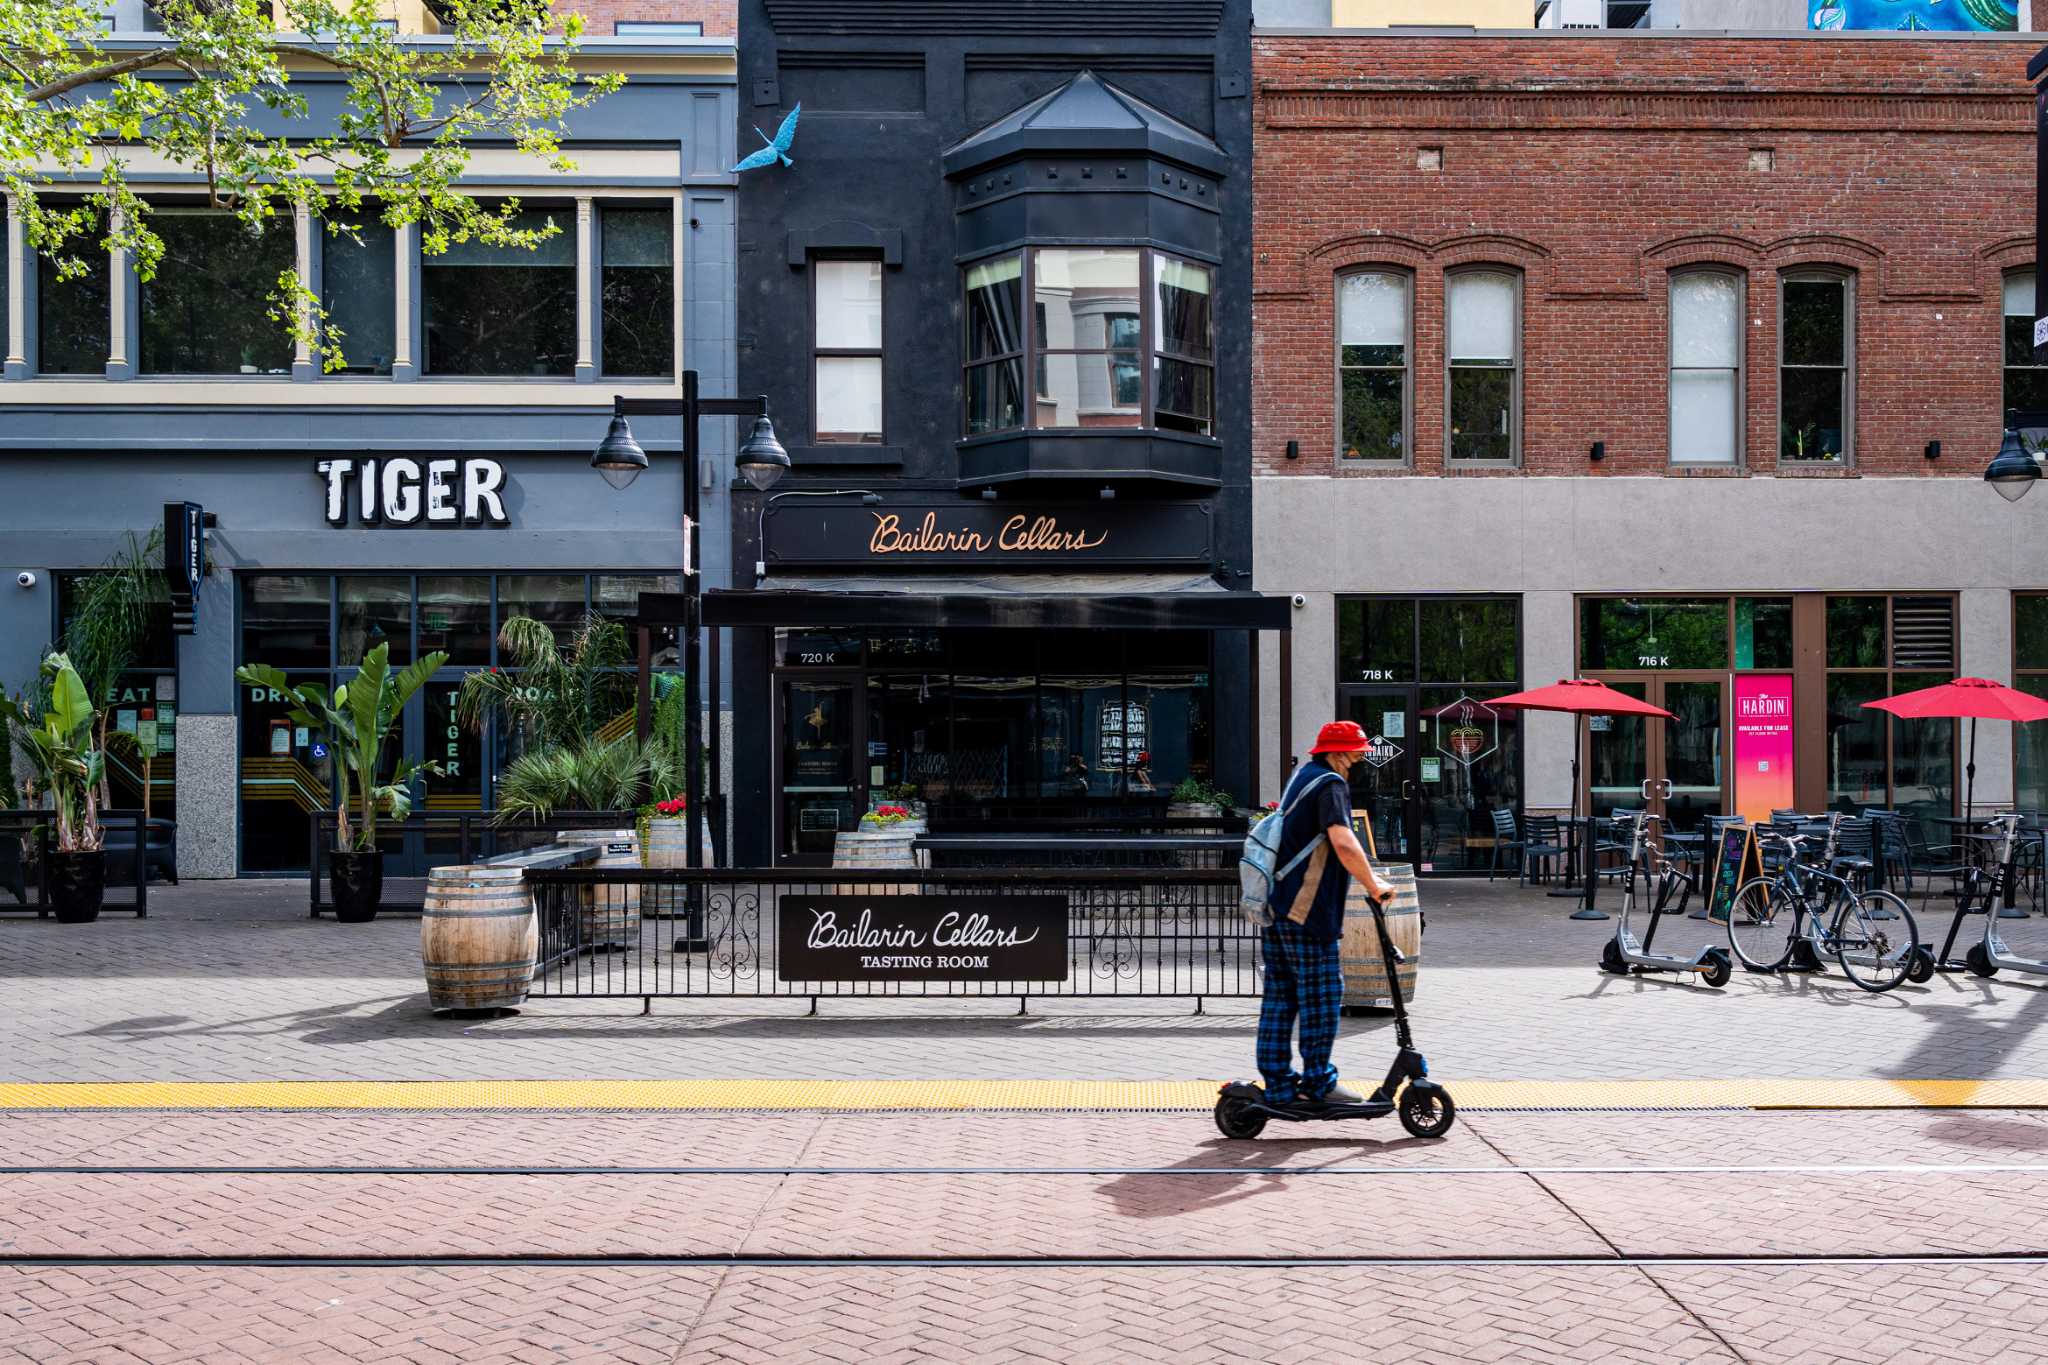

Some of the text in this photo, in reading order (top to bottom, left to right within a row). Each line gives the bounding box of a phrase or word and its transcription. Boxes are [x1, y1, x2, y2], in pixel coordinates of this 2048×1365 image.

[316, 457, 507, 523] TIGER
[999, 514, 1109, 551] Cellars
[190, 510, 199, 582] TIGER
[801, 653, 835, 663] 720 K
[1638, 656, 1669, 667] 716 K
[1362, 669, 1393, 680] 718 K
[107, 687, 150, 702] EAT
[1742, 700, 1785, 715] HARDIN
[446, 691, 460, 777] TIGER
[933, 911, 1040, 948] Cellars
[861, 956, 989, 968] TASTING ROOM
